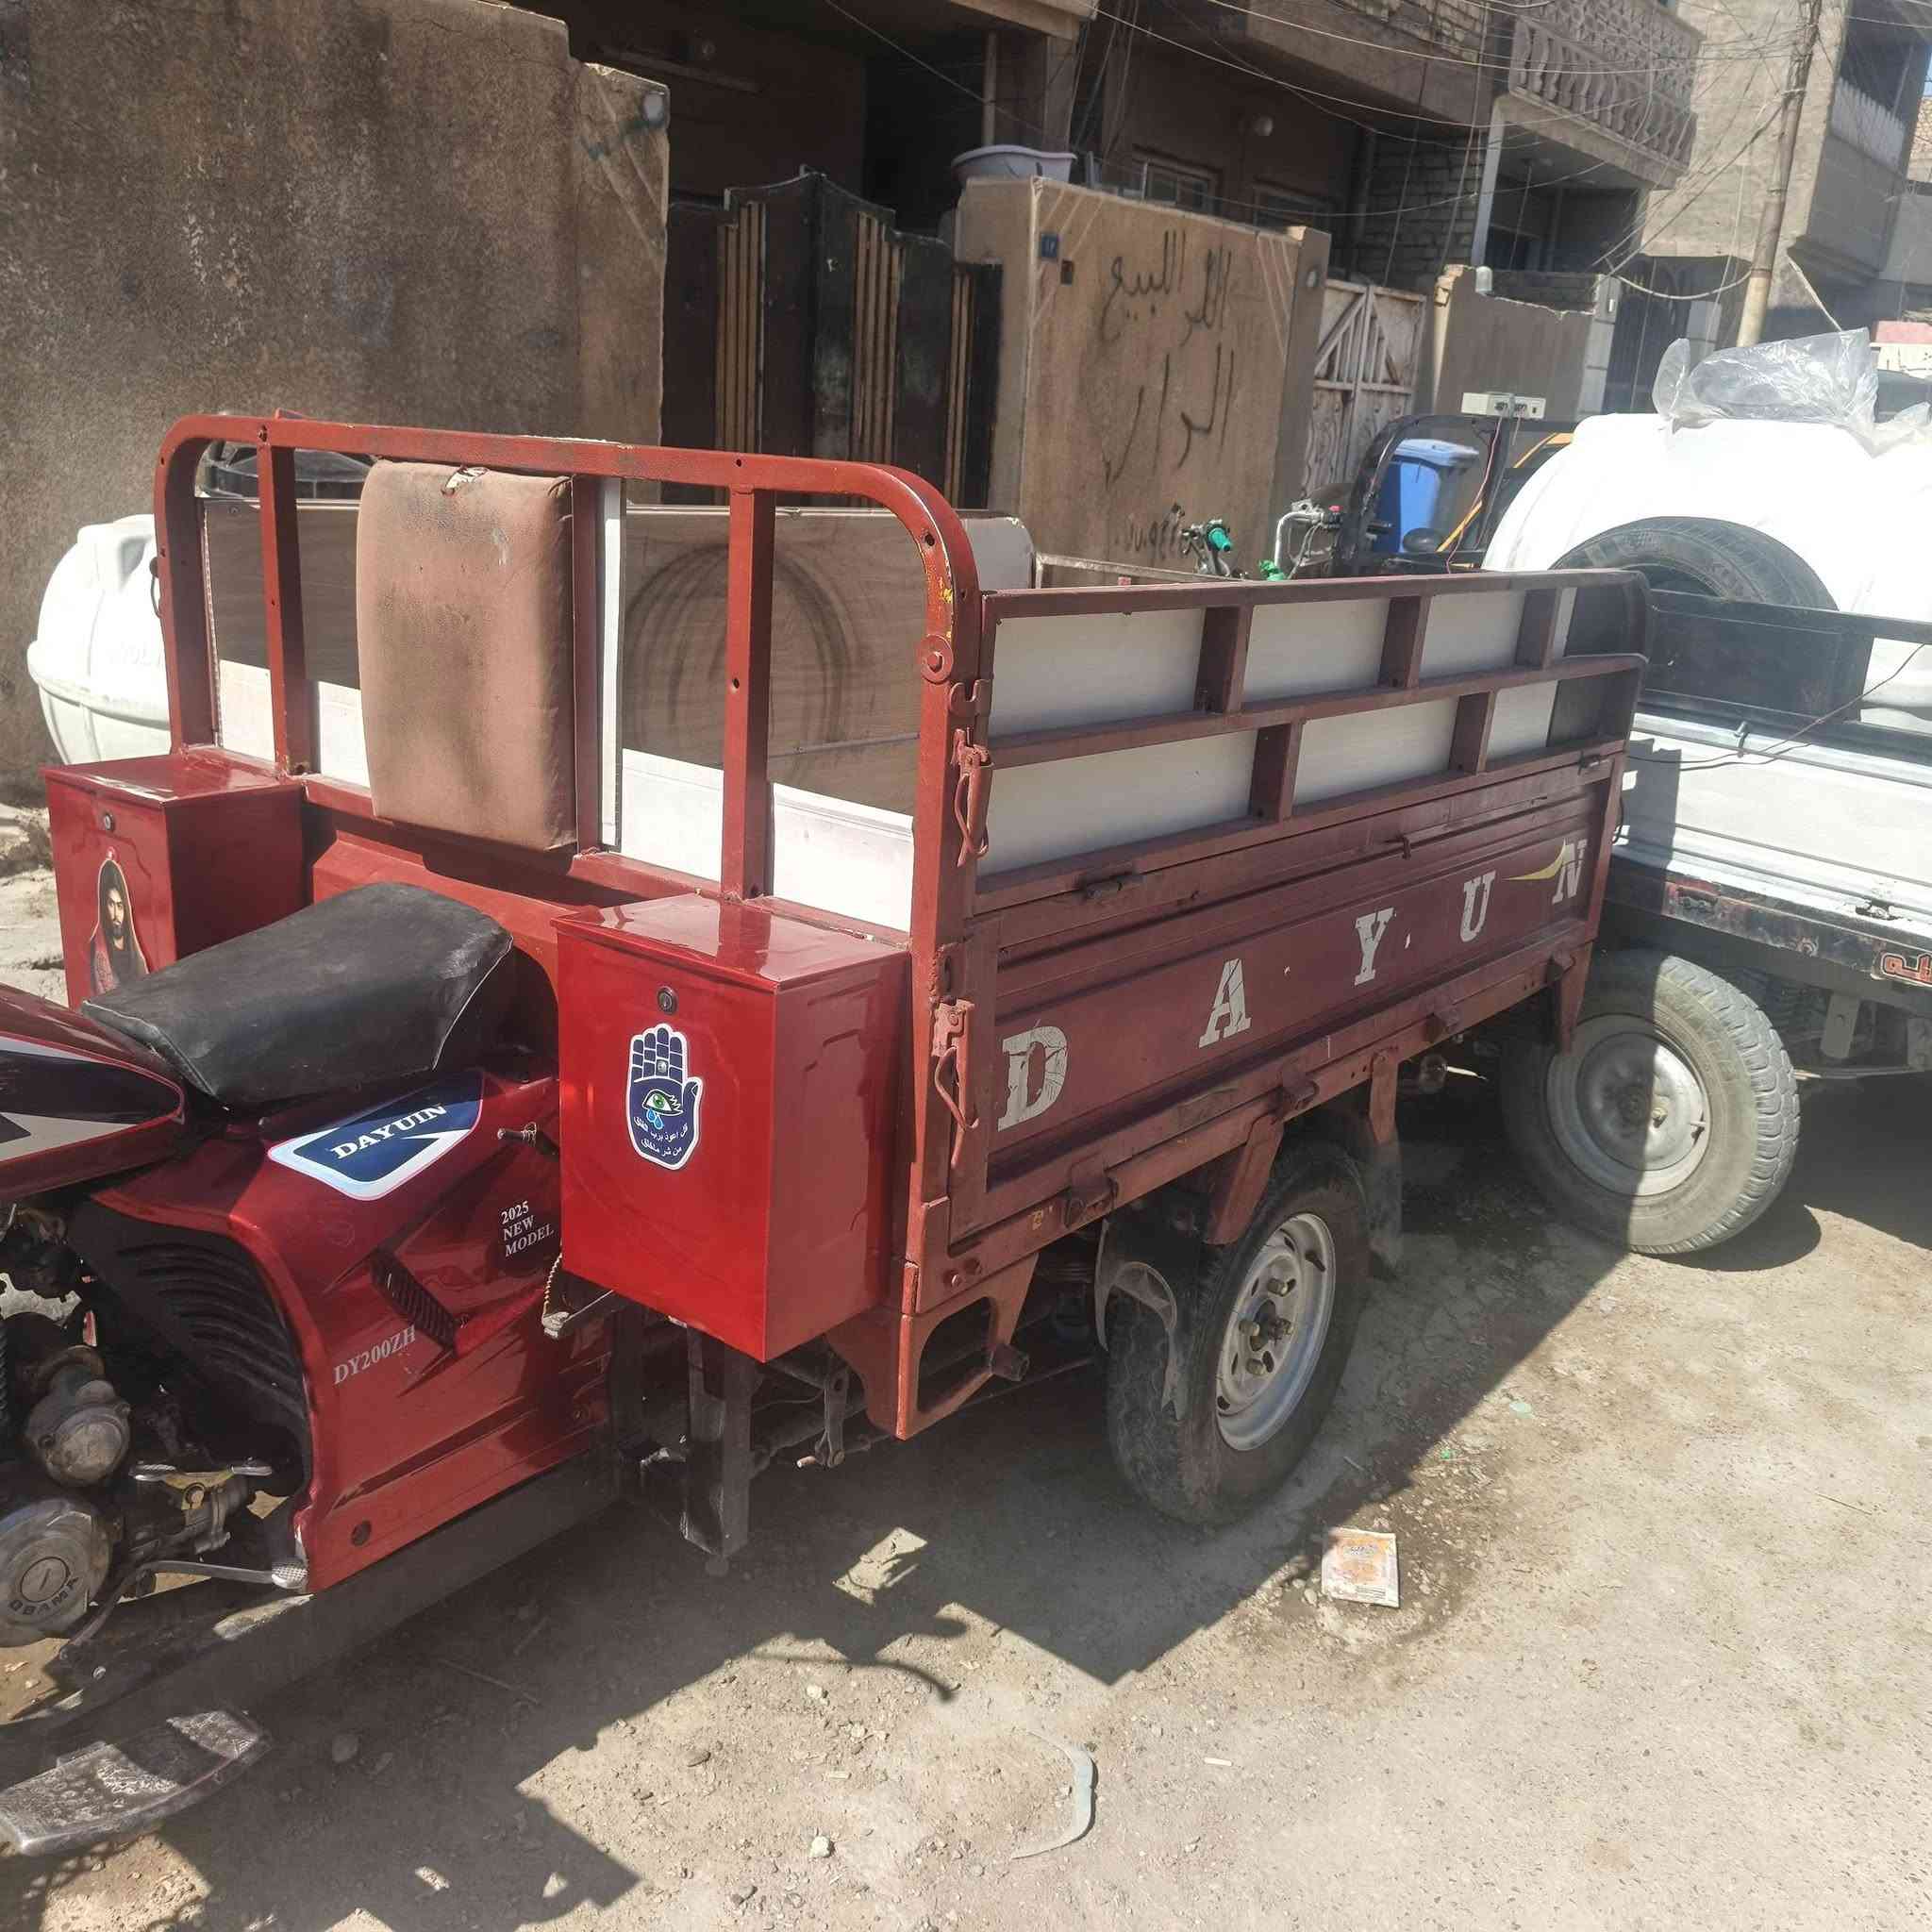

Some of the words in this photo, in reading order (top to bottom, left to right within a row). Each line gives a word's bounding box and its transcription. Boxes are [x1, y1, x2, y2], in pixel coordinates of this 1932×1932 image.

[329, 1105, 447, 1159] DAYUIN
[501, 1200, 529, 1224] 2025
[503, 1214, 535, 1241] NEW
[505, 1223, 555, 1257] MODEL
[333, 1324, 417, 1386] DY200ZH
